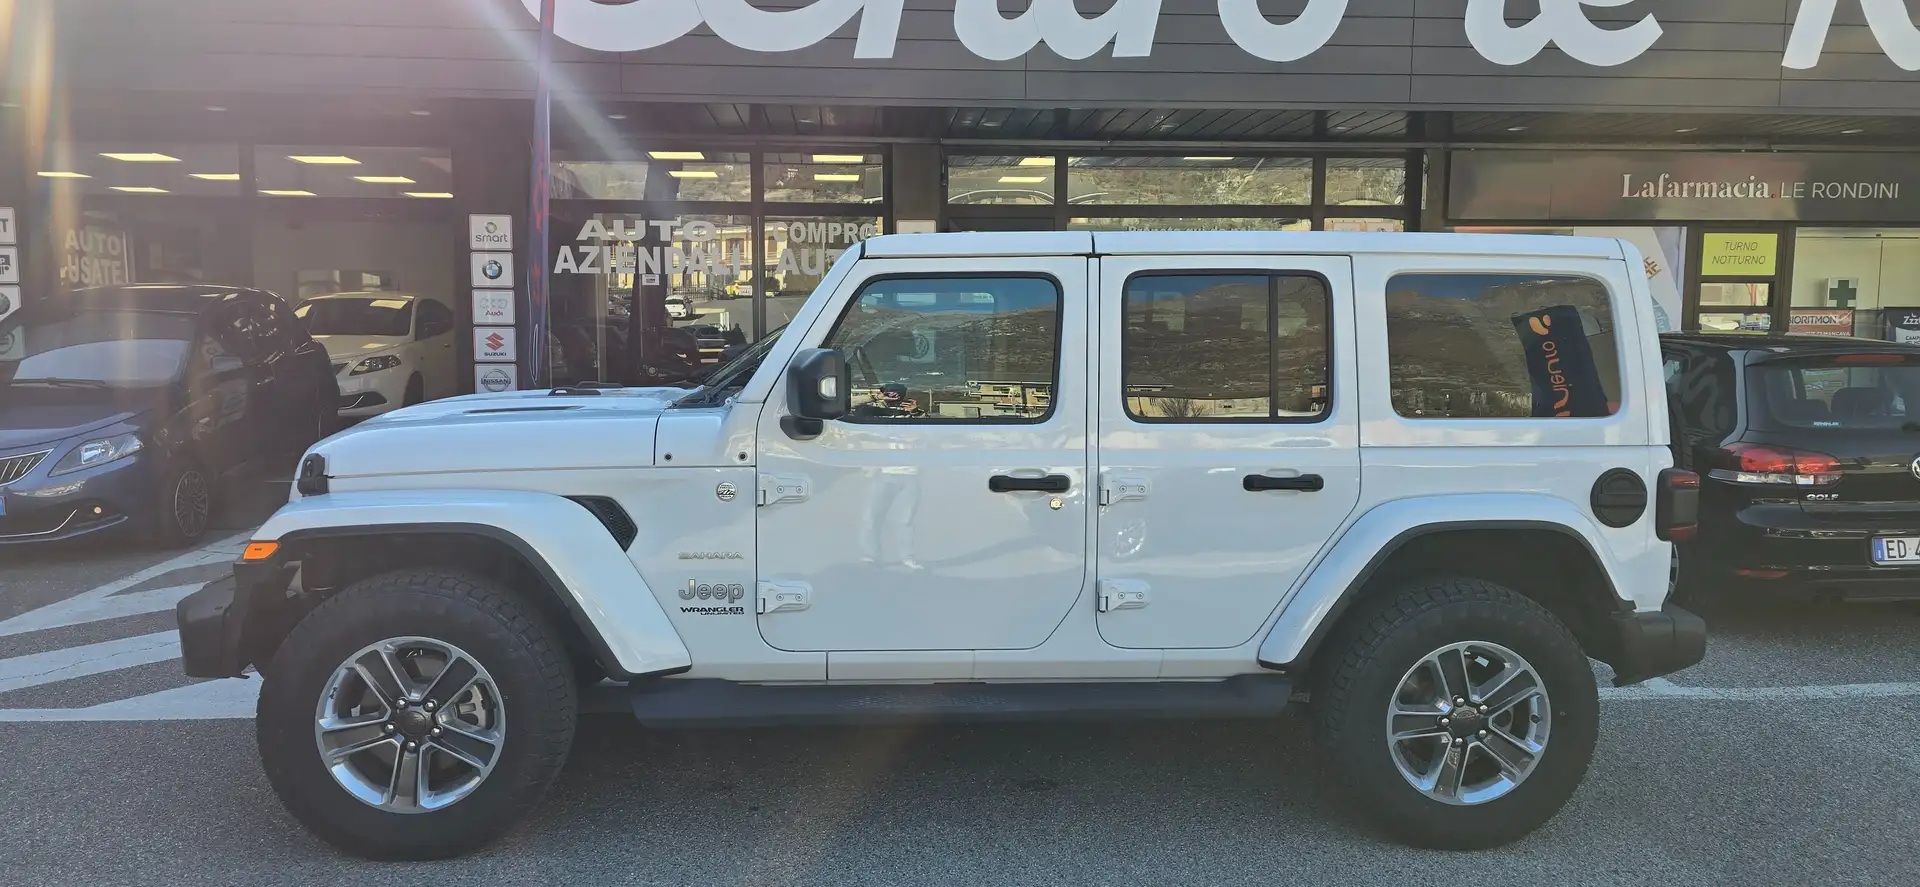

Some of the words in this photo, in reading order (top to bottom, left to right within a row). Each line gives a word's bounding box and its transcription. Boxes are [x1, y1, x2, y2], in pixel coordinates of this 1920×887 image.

[1780, 182, 1805, 199] LE
[1812, 182, 1899, 199] RONDINI
[475, 233, 508, 243] smart
[576, 219, 717, 242] AUTO
[65, 228, 121, 255] AUTO
[1724, 241, 1758, 251] TURNO
[554, 245, 742, 275] AZIENDALI
[1711, 255, 1766, 265] NOTTURNO
[67, 254, 122, 285] USATE
[482, 377, 510, 385] NISSAN
[678, 552, 744, 560] SAHARA
[1886, 540, 1907, 559] ED
[678, 578, 744, 604] Jeep
